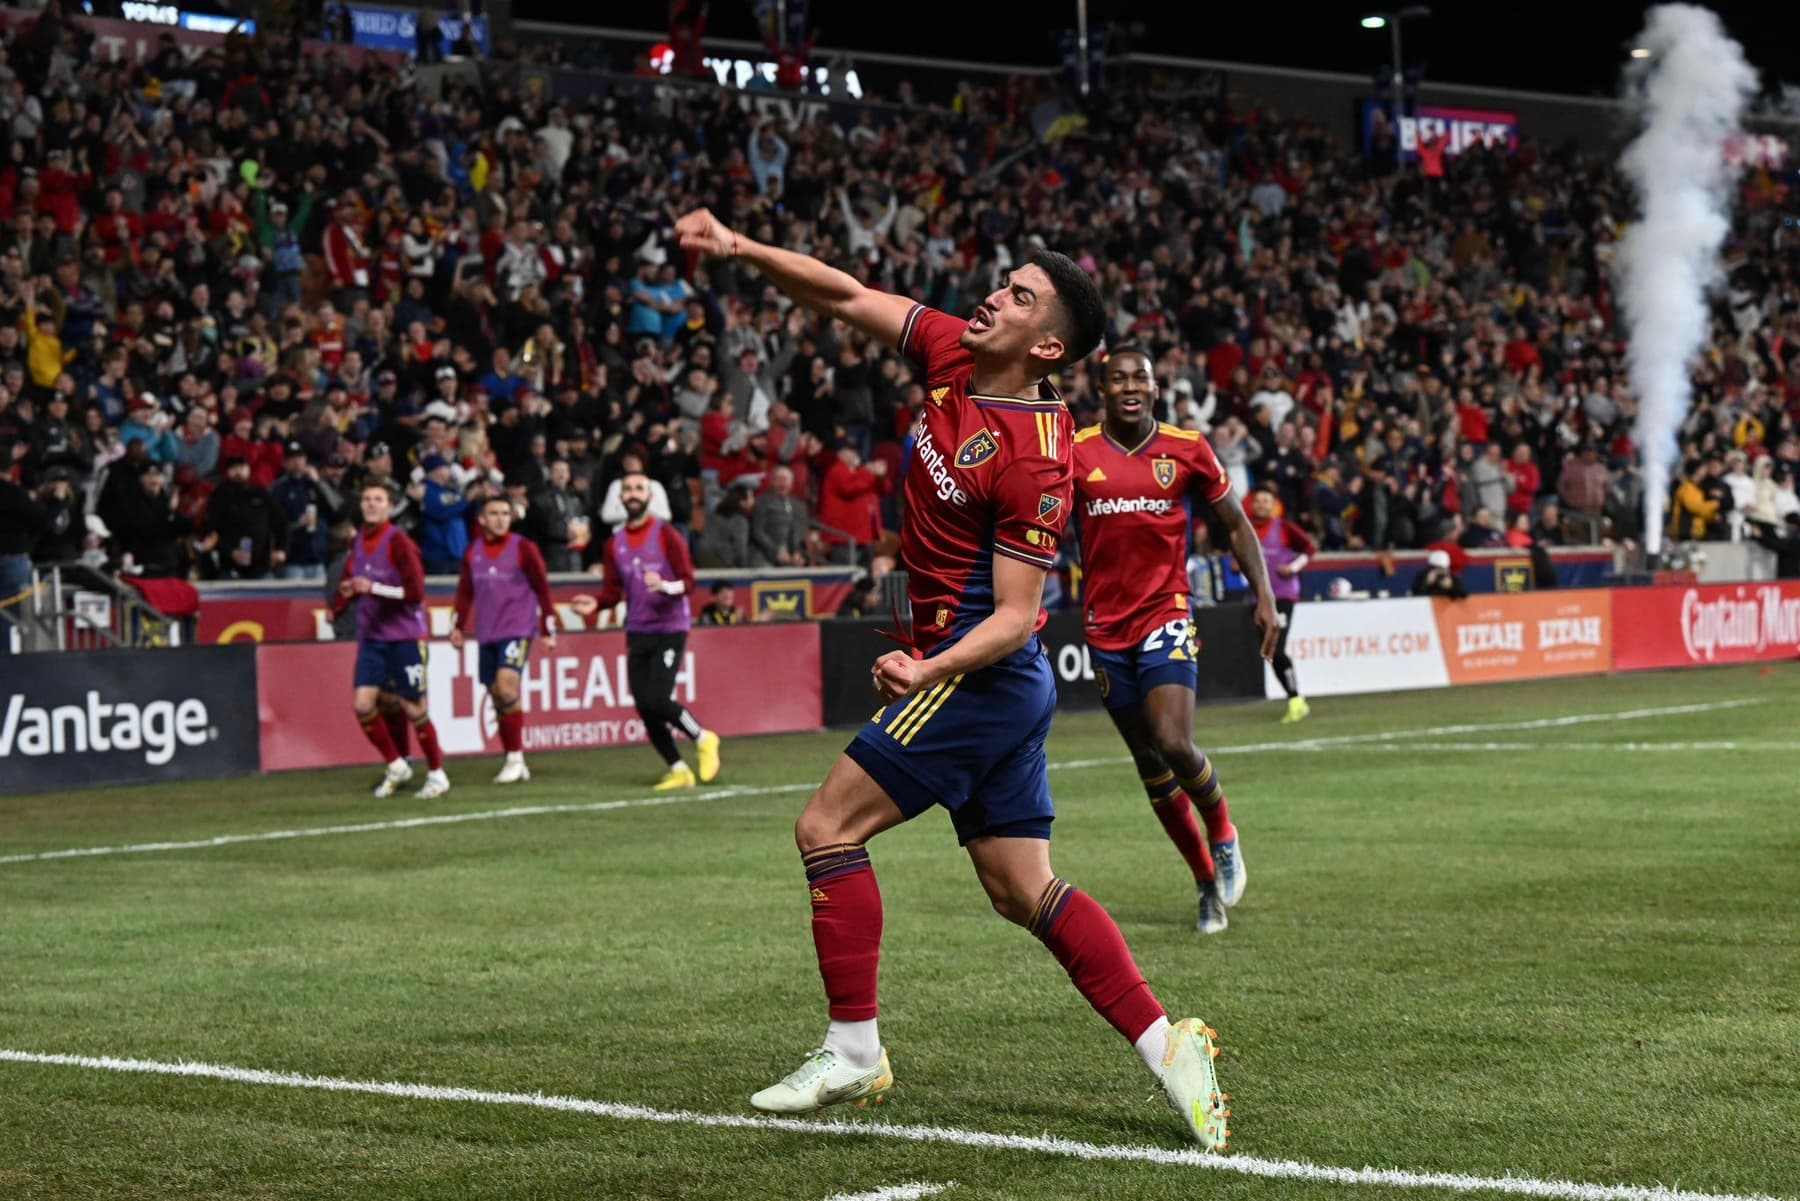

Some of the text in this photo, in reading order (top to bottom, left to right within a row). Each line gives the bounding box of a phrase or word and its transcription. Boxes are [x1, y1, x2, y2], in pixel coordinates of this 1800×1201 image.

[1086, 496, 1173, 516] LifeVantage
[1143, 618, 1189, 652] 29
[1457, 621, 1524, 656] UTAH
[1538, 616, 1602, 649] UTAH
[1682, 587, 1758, 661] Captain
[1290, 631, 1431, 661] ISITUTAH.COM
[521, 650, 697, 714] HEALH
[521, 720, 622, 749] UNIVERSITY
